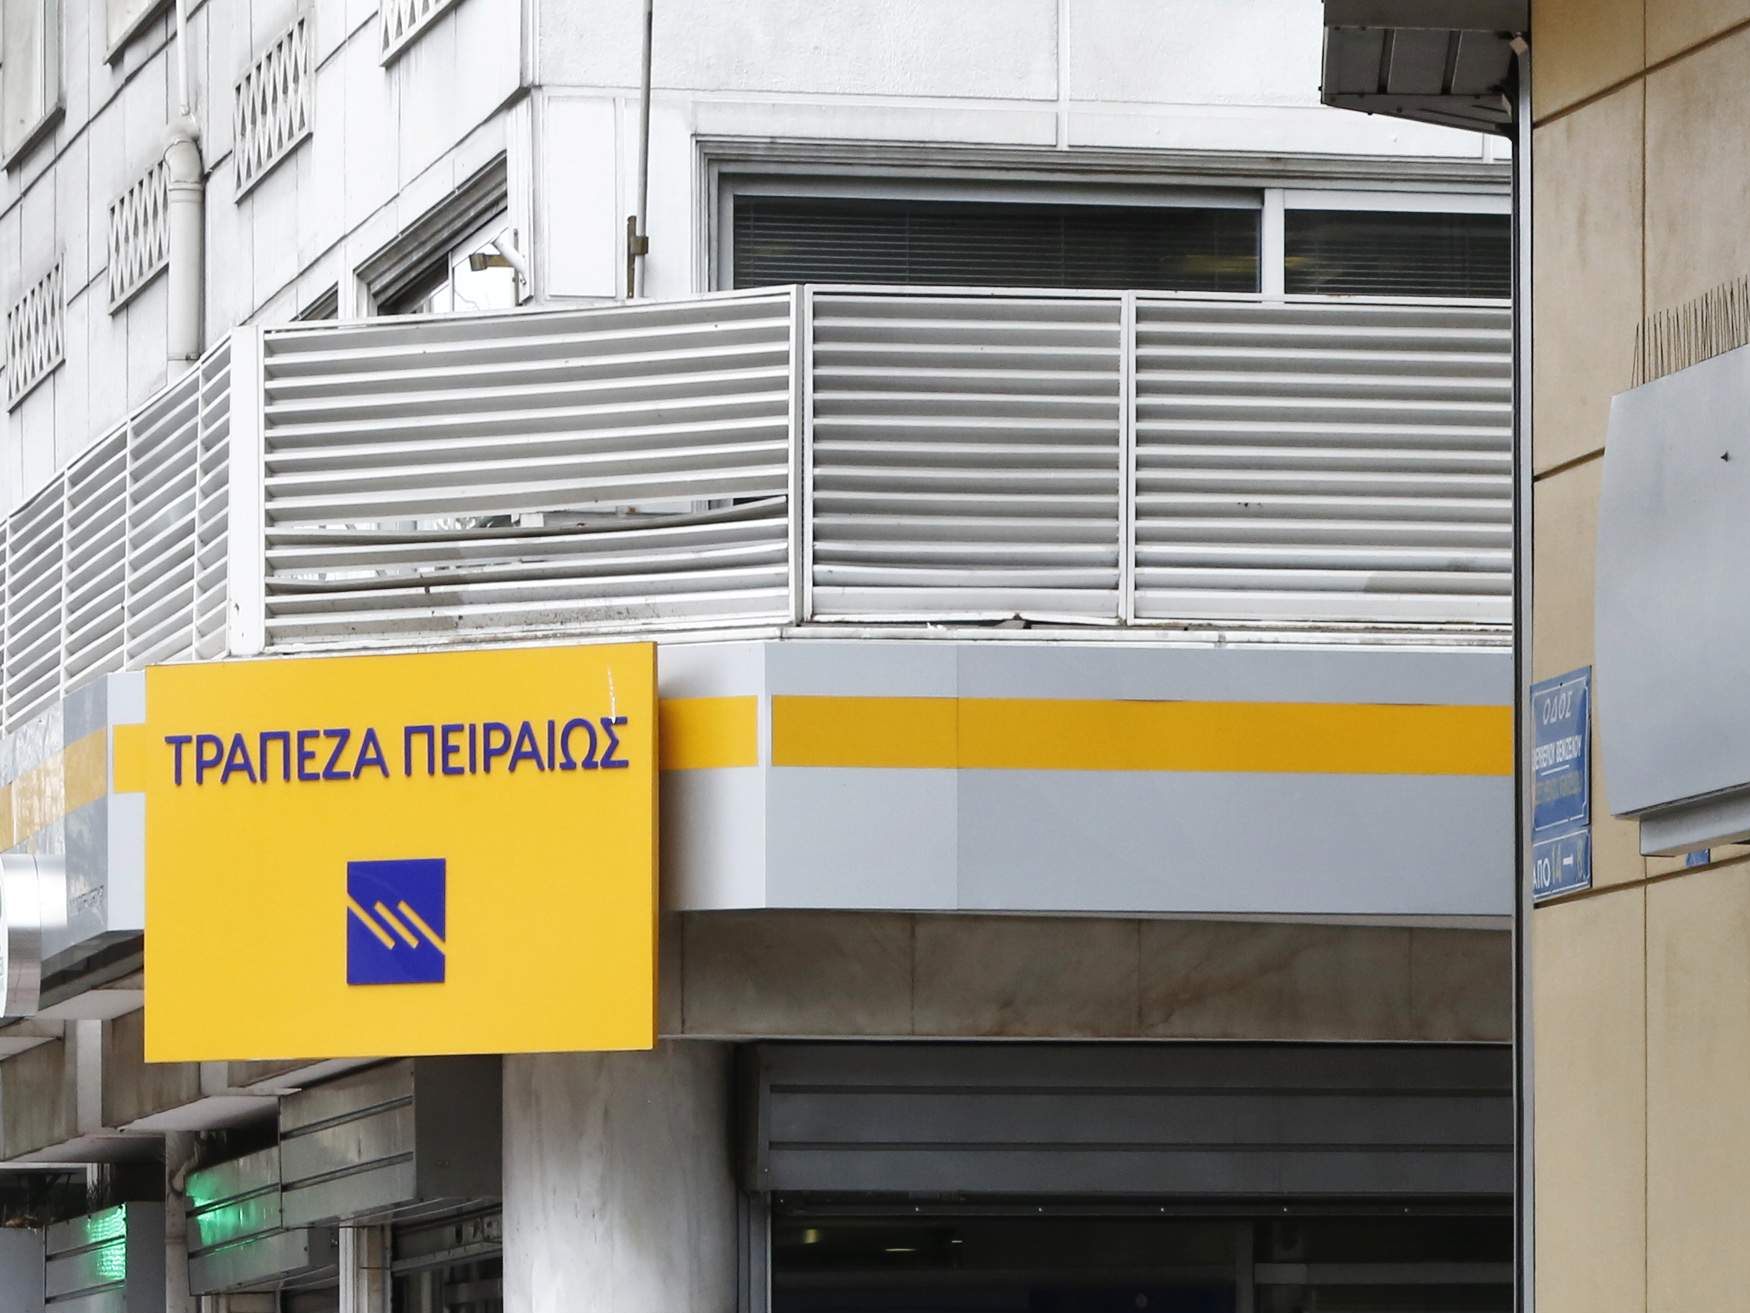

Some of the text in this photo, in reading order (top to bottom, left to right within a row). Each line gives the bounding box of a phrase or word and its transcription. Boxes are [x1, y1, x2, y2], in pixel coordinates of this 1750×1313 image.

[1542, 691, 1573, 726] ΟΔΟΣ
[164, 716, 630, 786] ΤΡΑΠΕΖΑ ΠΕΙΡΑΙΩΣ
